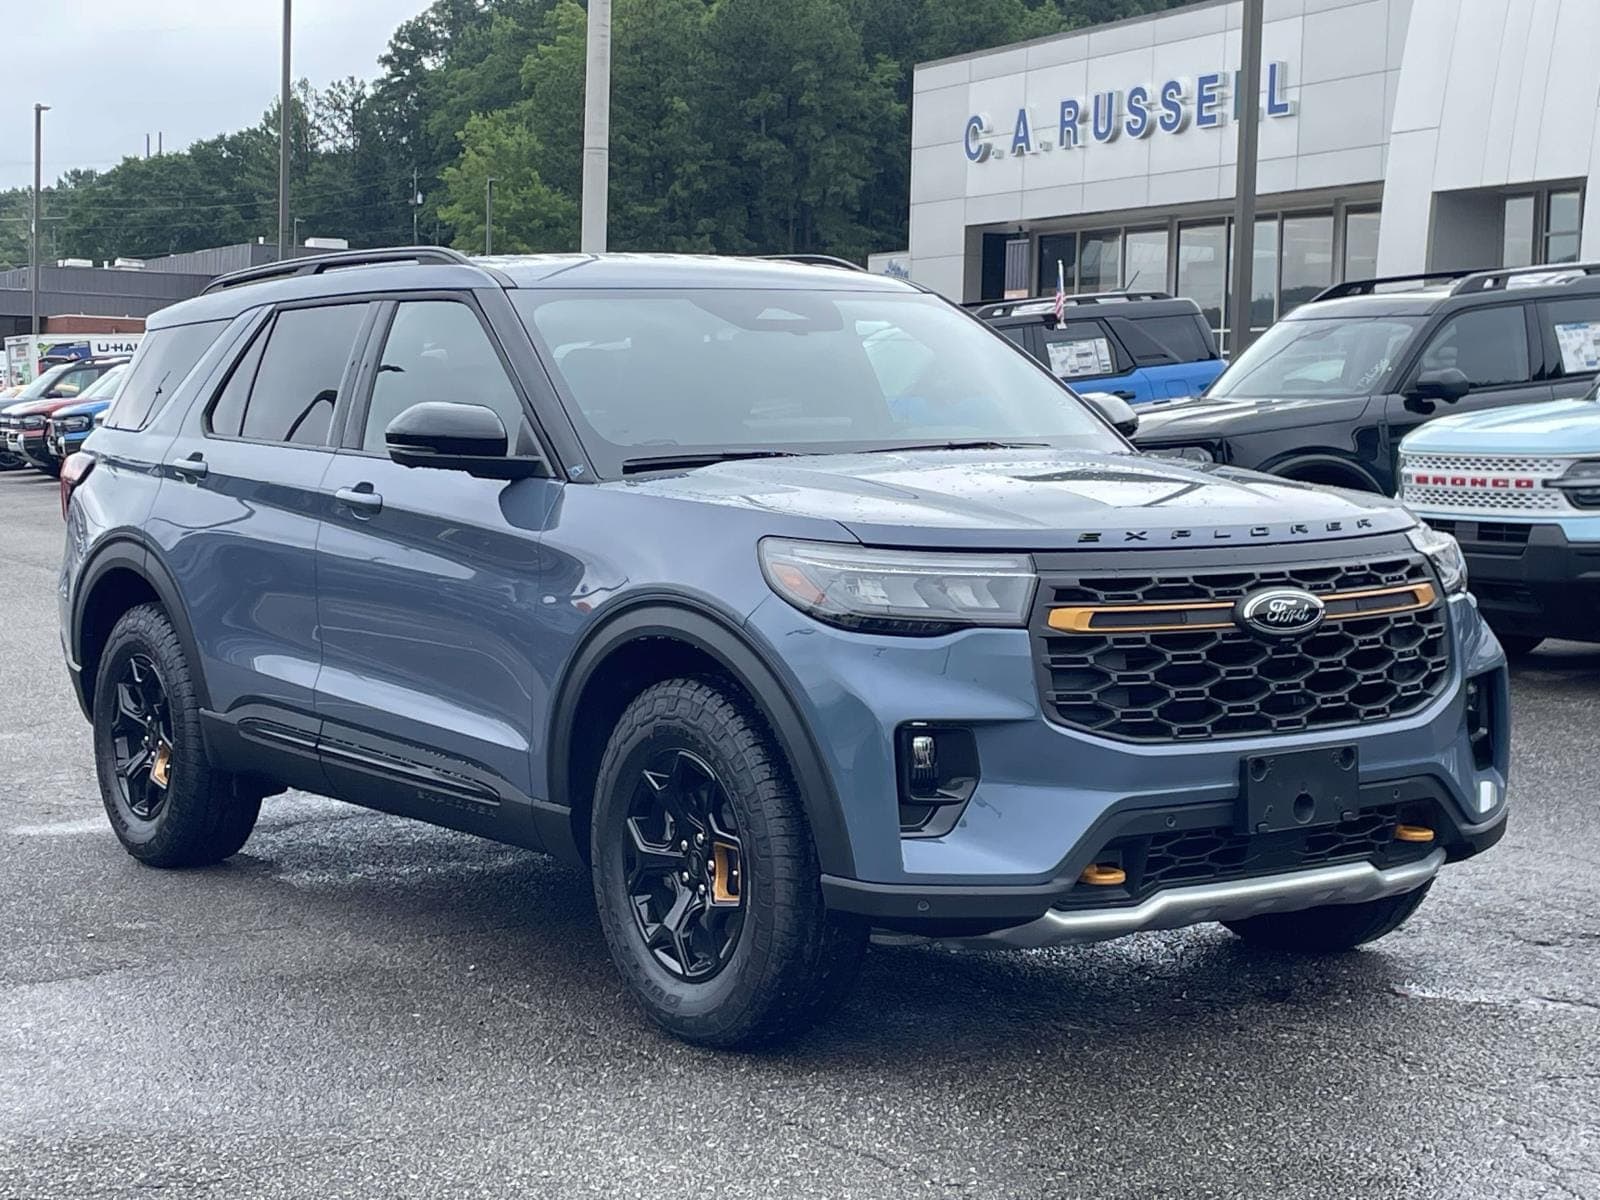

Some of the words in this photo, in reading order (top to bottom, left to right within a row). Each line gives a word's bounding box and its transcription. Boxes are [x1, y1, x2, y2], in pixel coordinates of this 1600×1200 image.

[1415, 475, 1534, 488] BRONCO
[1077, 518, 1373, 544] EXPLORER
[1266, 599, 1310, 623] Ford
